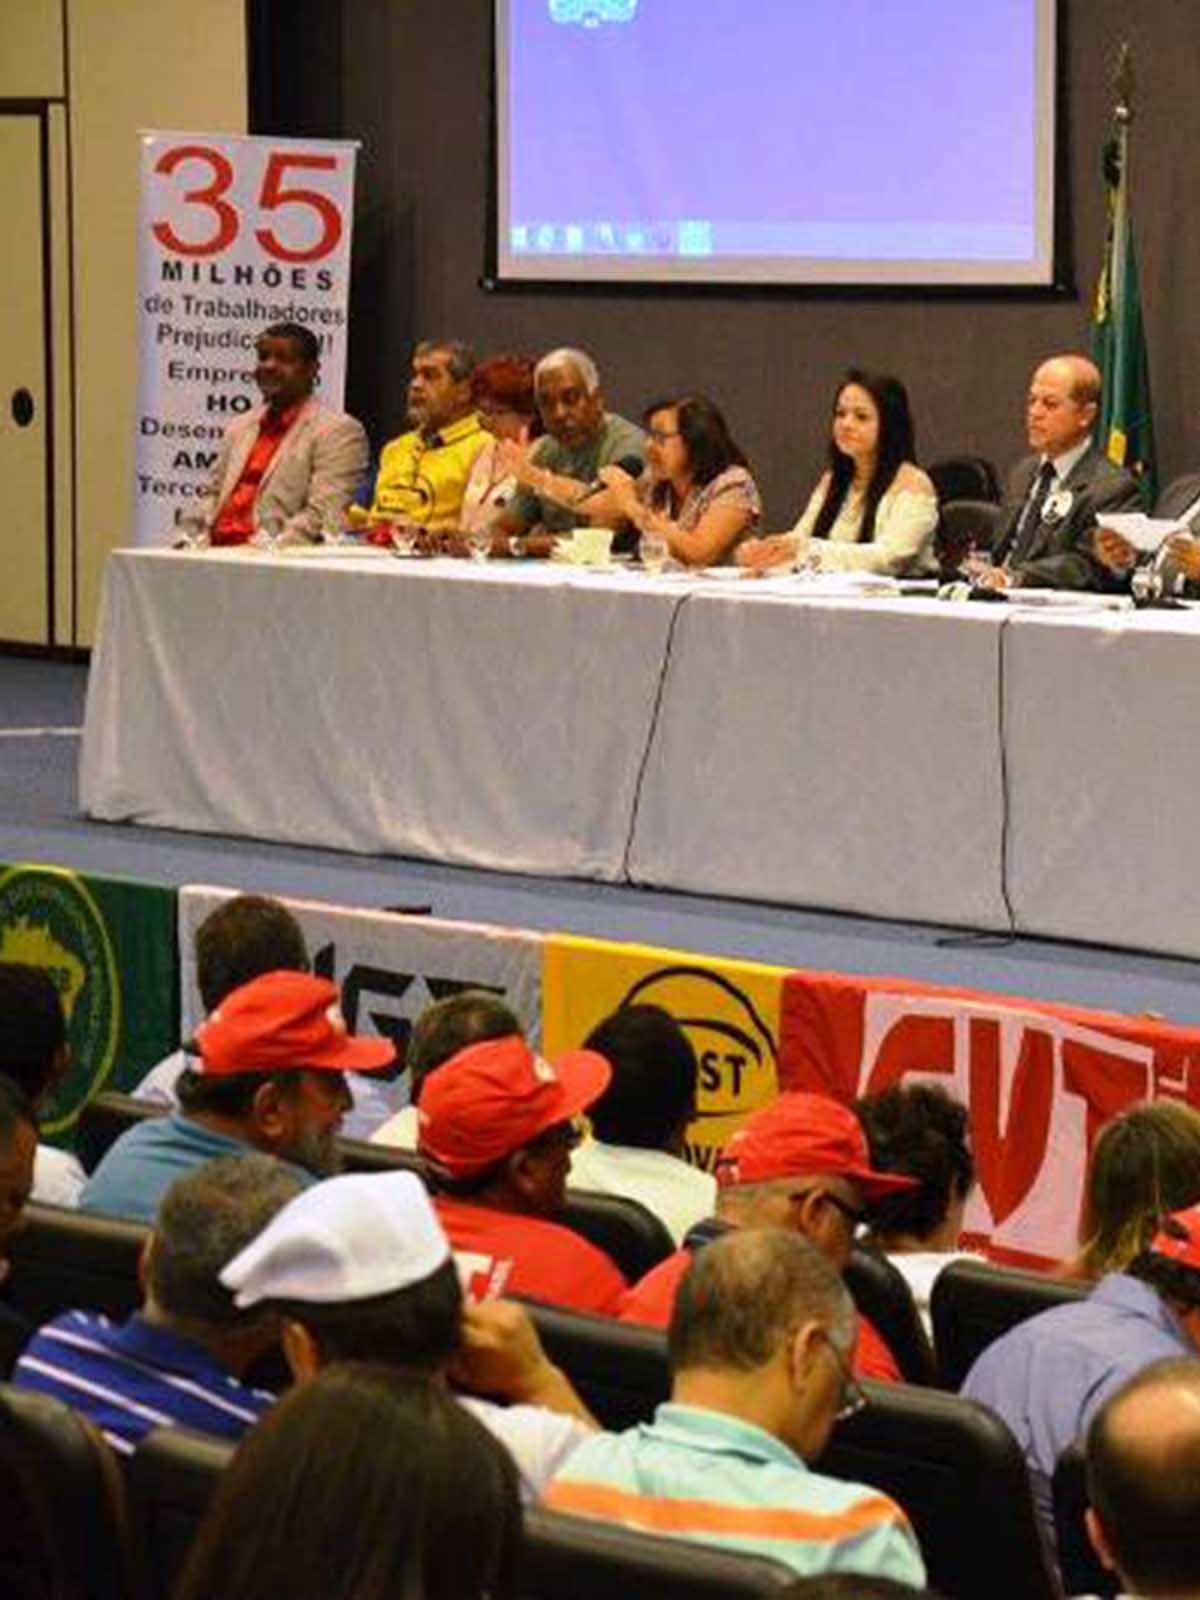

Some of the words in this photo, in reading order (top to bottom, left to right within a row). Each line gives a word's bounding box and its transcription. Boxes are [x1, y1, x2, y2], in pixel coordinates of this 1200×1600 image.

[153, 145, 342, 263] 35
[161, 260, 333, 291] MILHÕES
[145, 293, 174, 315] de
[183, 295, 345, 326] Trabalhadores
